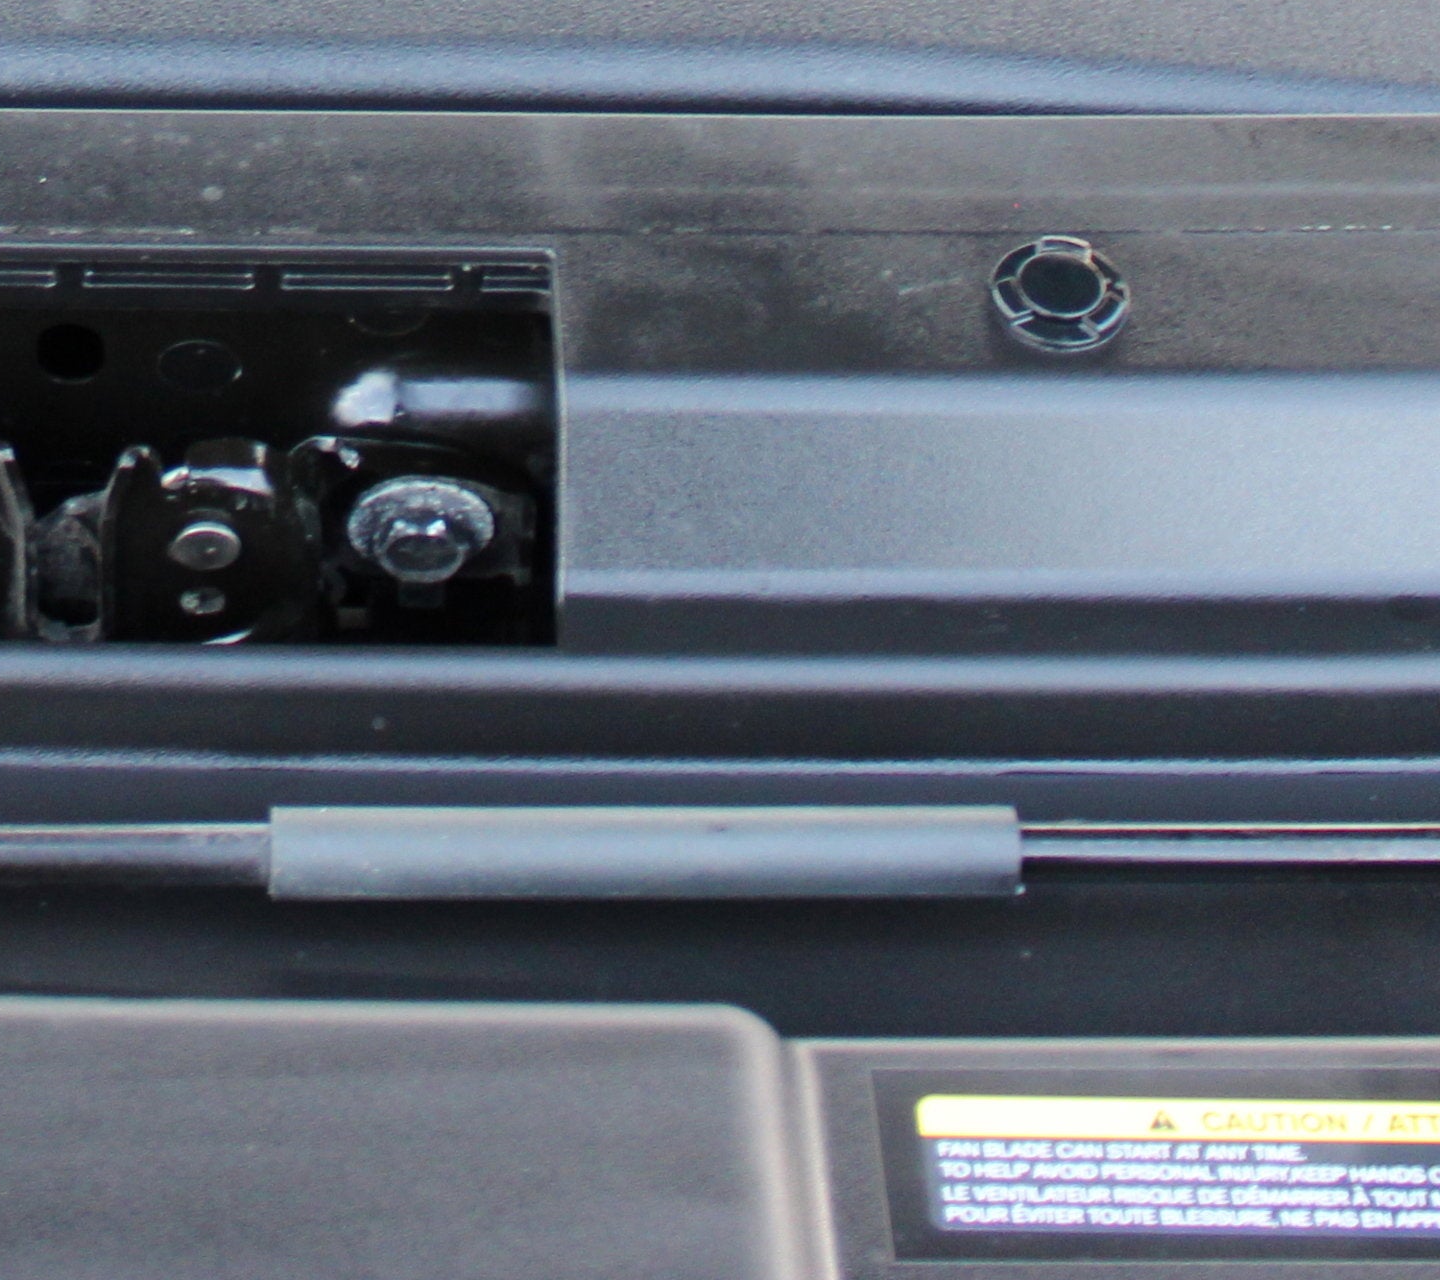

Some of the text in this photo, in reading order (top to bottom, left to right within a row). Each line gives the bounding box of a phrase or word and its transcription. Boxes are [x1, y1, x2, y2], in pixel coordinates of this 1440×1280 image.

[1201, 1111, 1348, 1133] CAUTION
[937, 1140, 1307, 1162] FAN BLADE CAN START AT ANY TIME.
[939, 1160, 971, 1179] TO
[973, 1161, 1031, 1180] HELP
[1033, 1161, 1100, 1181] AVOID
[1100, 1162, 1217, 1182] PERSONAL
[1348, 1164, 1427, 1185] HANDS
[941, 1184, 970, 1202] LE
[972, 1185, 1112, 1204] VENTILATEUR
[1113, 1185, 1197, 1205] RISQUE
[1197, 1186, 1230, 1205] DE
[1230, 1184, 1350, 1206] DÉMARRER
[1352, 1184, 1372, 1207] À
[1371, 1187, 1428, 1207] TOUT
[944, 1206, 1010, 1223] POUR
[1011, 1203, 1085, 1225] ÉVITER
[1086, 1206, 1159, 1226] TOUTE
[1280, 1208, 1313, 1227] NE
[1313, 1208, 1360, 1228] PAS
[1360, 1209, 1394, 1228] EN
